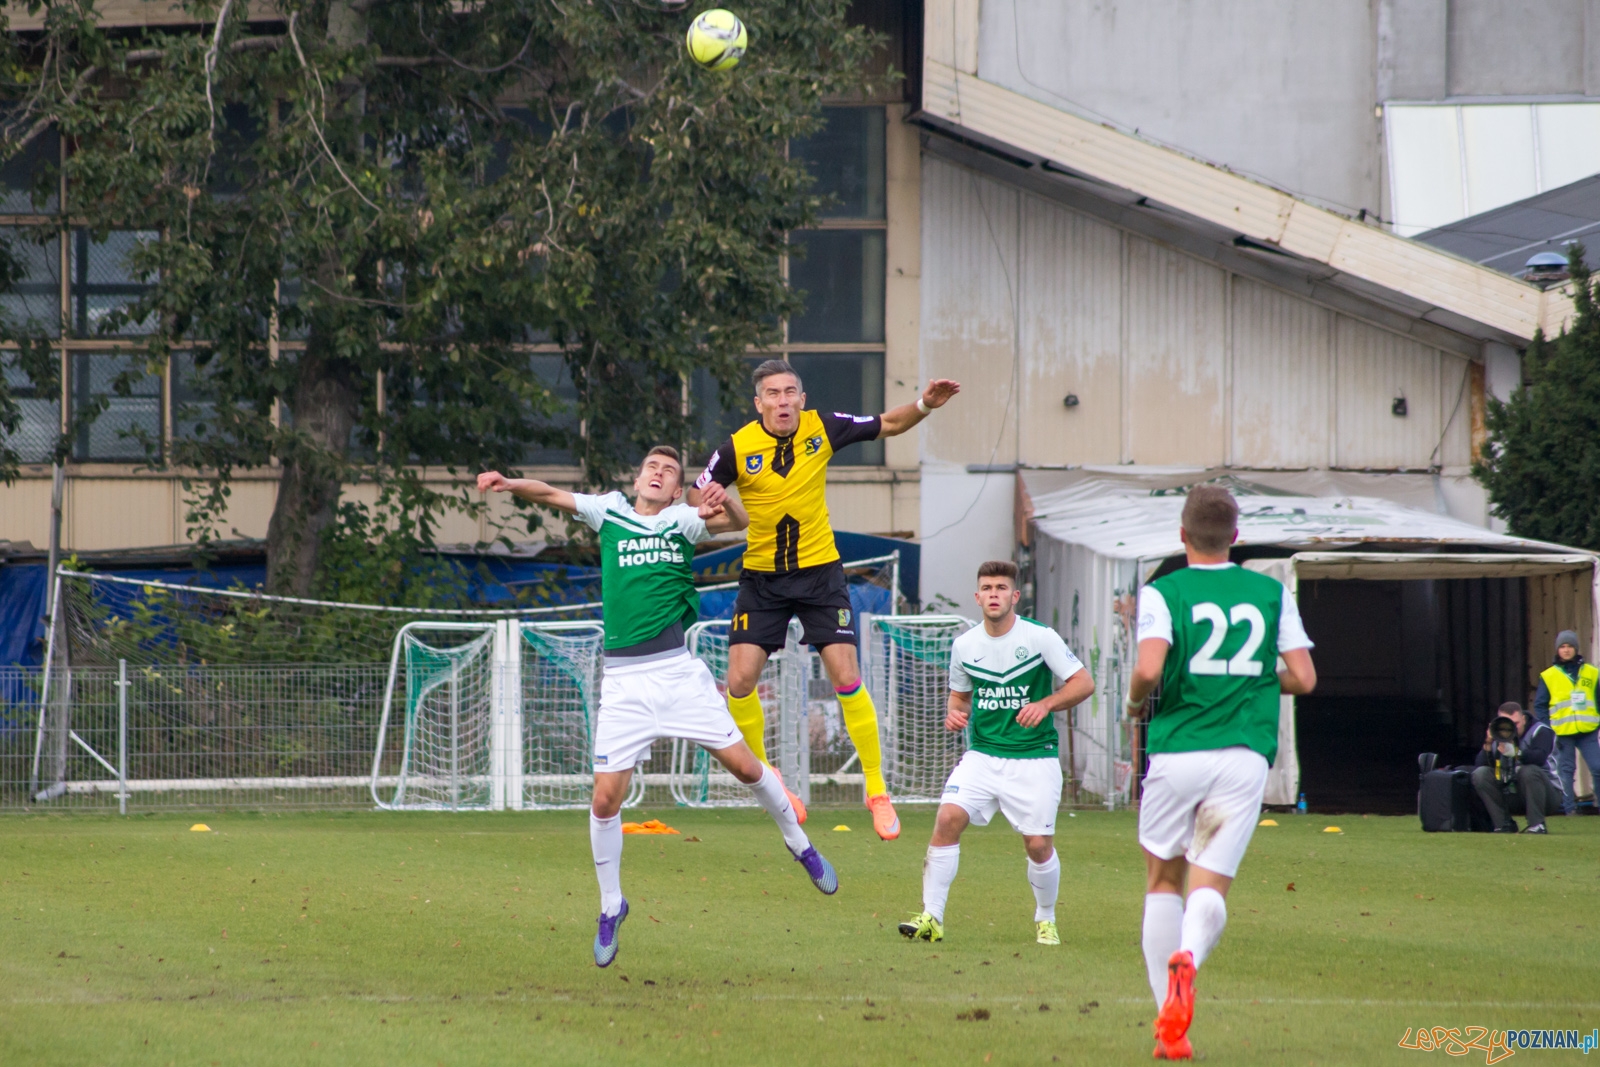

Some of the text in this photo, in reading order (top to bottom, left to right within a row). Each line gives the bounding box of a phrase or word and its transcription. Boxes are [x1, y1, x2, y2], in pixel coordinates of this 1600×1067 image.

[617, 537, 680, 552] FAMILY
[618, 551, 684, 567] HOUSE
[732, 613, 749, 631] 11
[1189, 602, 1266, 676] 22
[978, 685, 1030, 698] FAMILY
[977, 697, 1030, 710] HOUSE
